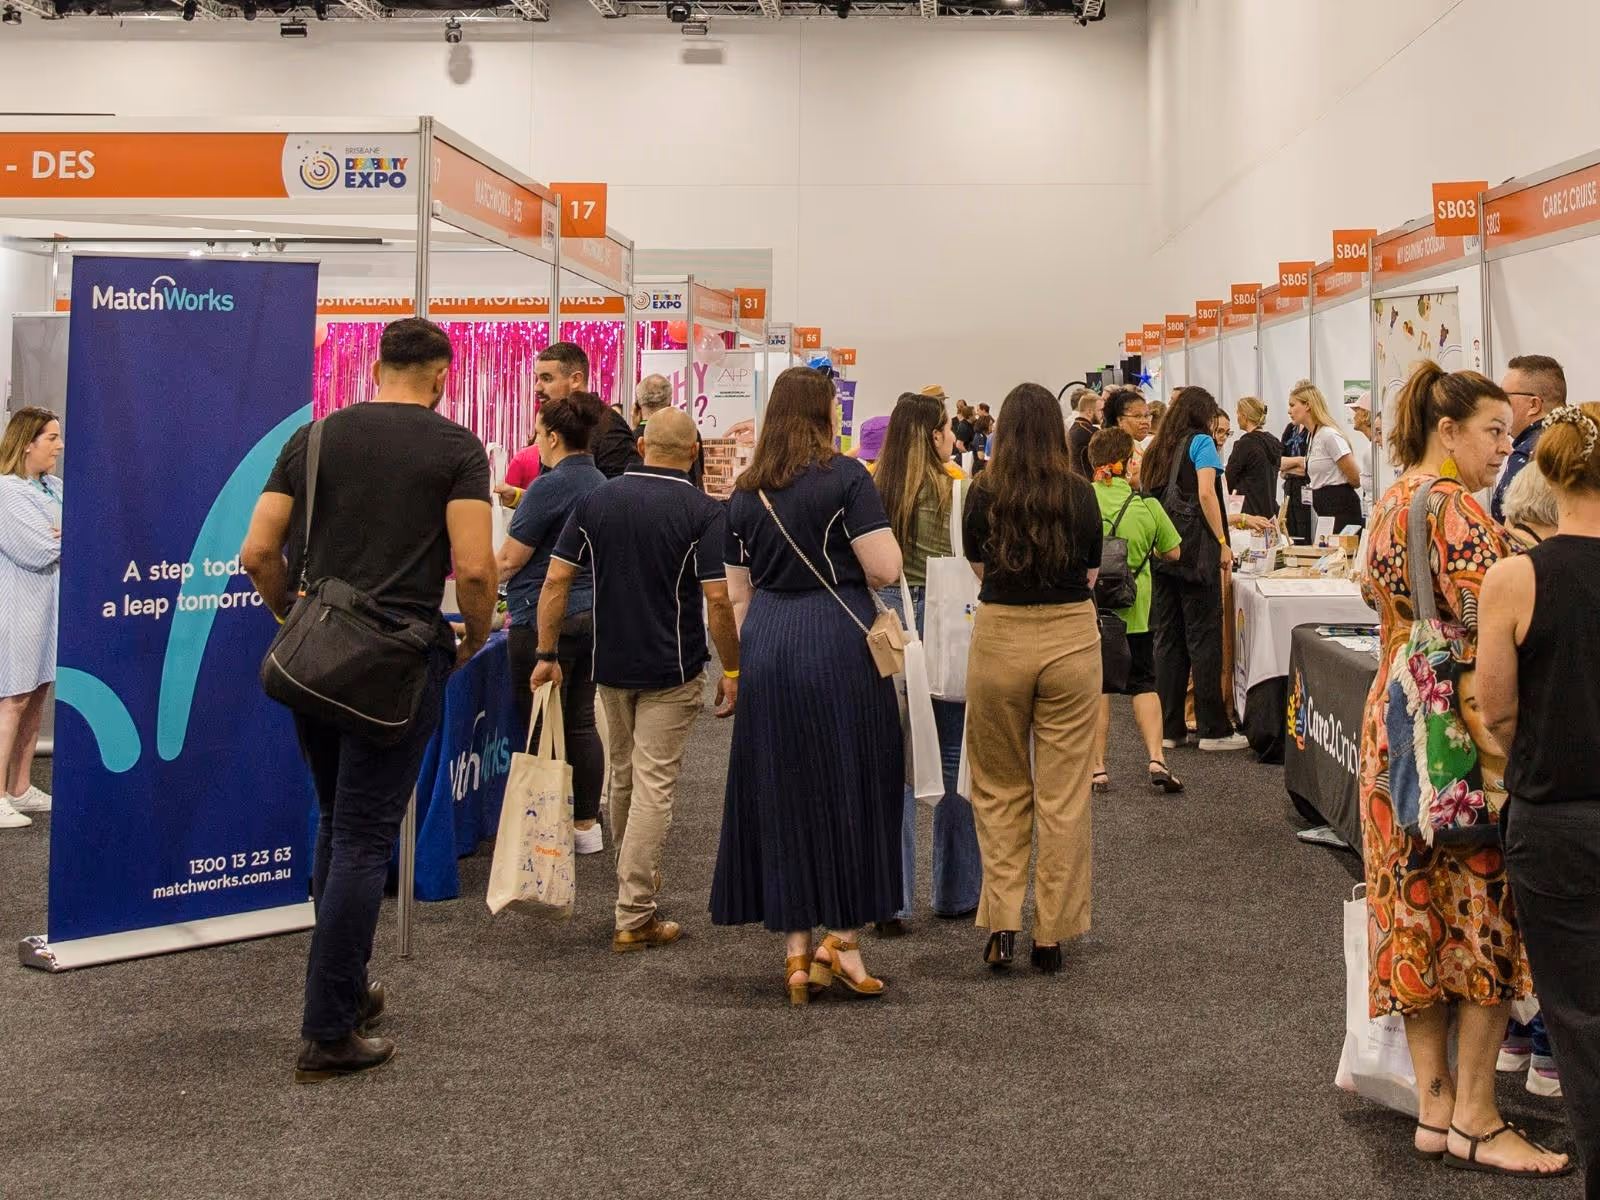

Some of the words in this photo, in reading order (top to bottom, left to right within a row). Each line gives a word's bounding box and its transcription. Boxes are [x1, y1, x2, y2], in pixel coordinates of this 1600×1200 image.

[345, 147, 382, 155] BRISBANE
[32, 150, 95, 179] DES
[344, 171, 407, 188] EXPO
[1542, 192, 1562, 219] CARE
[1562, 188, 1569, 213] 2
[1569, 180, 1597, 211] CRUISE
[570, 201, 596, 220] 17
[1438, 199, 1476, 219] SB03
[1486, 212, 1501, 236] SB03
[1336, 243, 1367, 259] SB04
[1281, 272, 1308, 287] SB05
[92, 284, 235, 312] MatchWorks
[316, 296, 404, 306] USTRALIAN
[474, 296, 605, 306] PROFESSINALS
[652, 301, 682, 309] EXPO
[744, 297, 758, 309] 31
[1233, 293, 1256, 305] SB06
[1198, 309, 1218, 319] SB07
[1144, 330, 1160, 339] SB09
[1166, 322, 1184, 331] SB08
[806, 334, 817, 342] 55
[1126, 338, 1141, 347] SB10
[123, 560, 141, 583] A
[149, 560, 194, 584] step
[203, 554, 248, 576] toda
[102, 600, 116, 618] a
[124, 594, 169, 620] leap
[177, 590, 264, 612] tomorro
[189, 856, 227, 875] 1300
[231, 853, 246, 869] 13
[251, 849, 270, 867] 23
[274, 846, 292, 863] 63
[152, 867, 292, 899] matchworks.com.au
